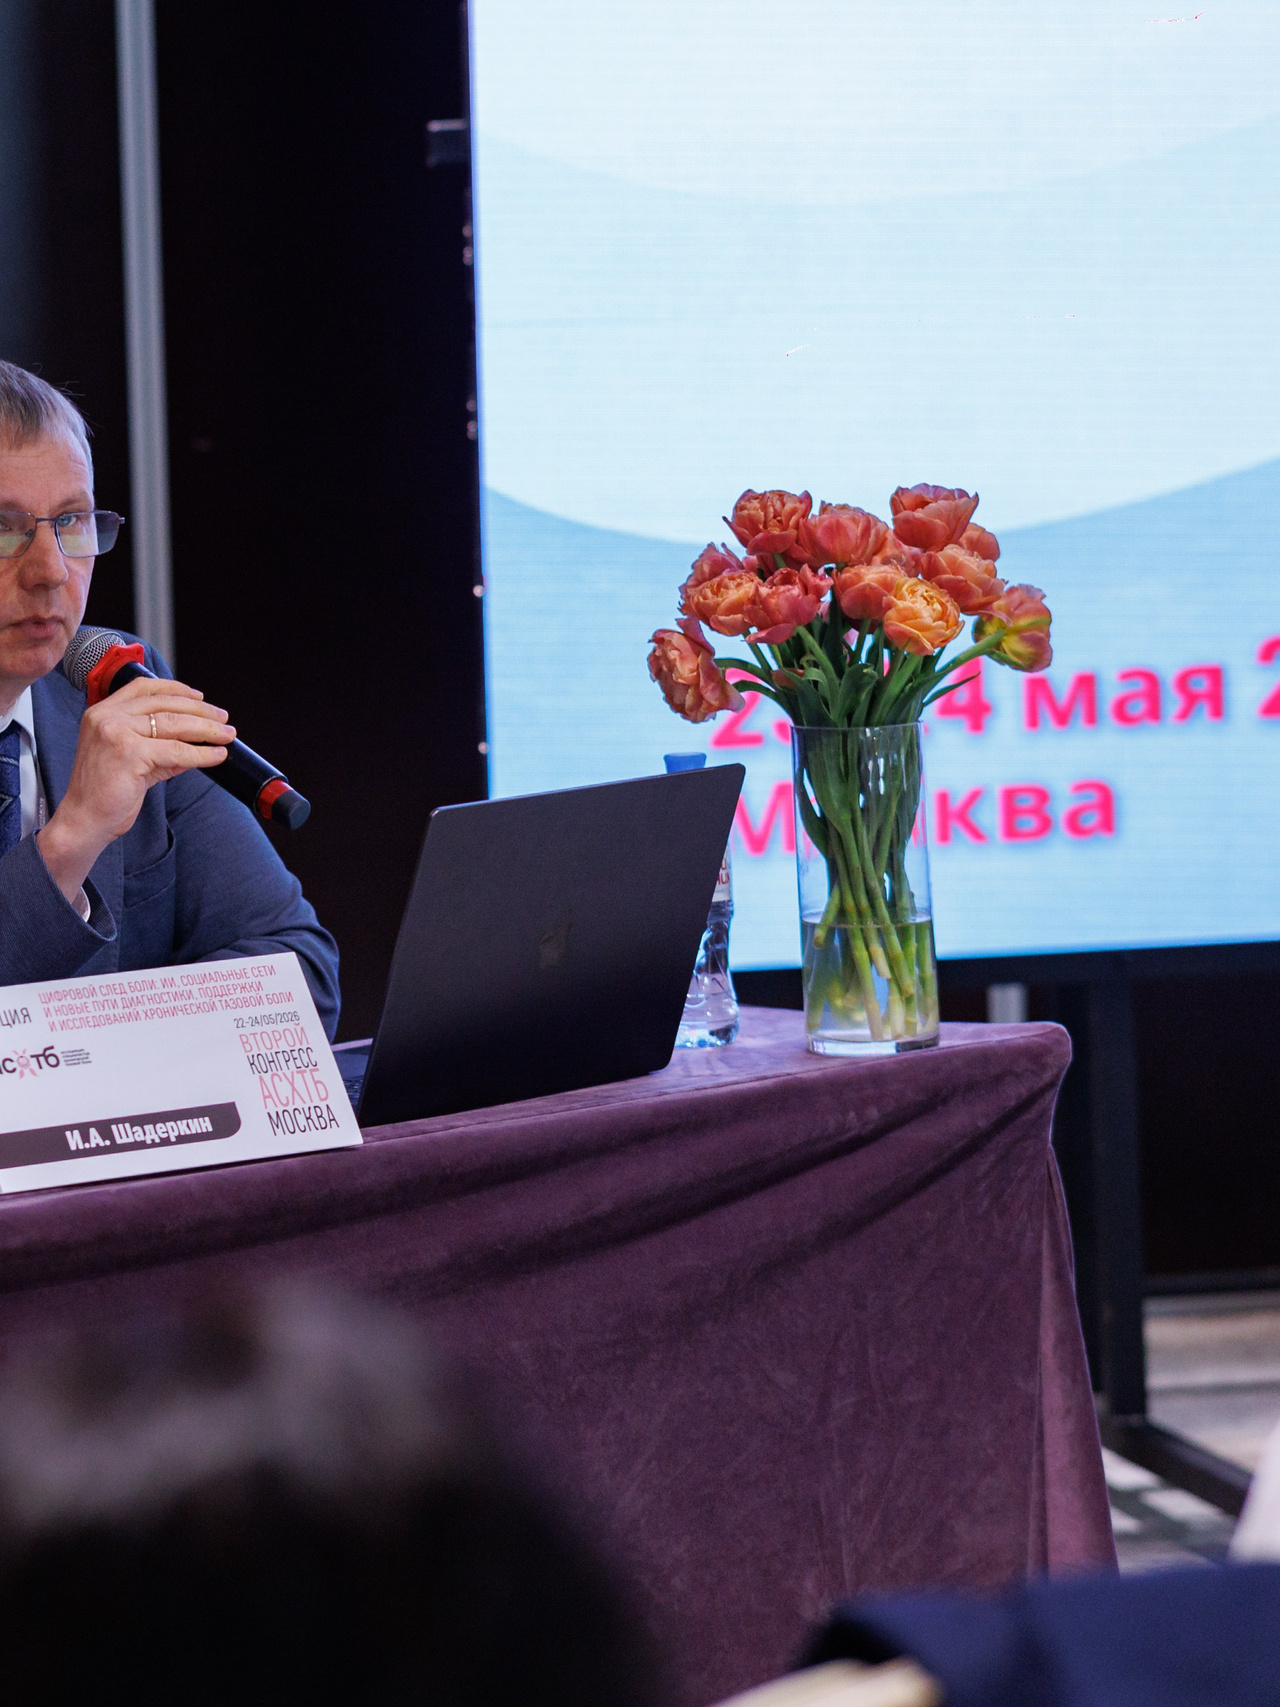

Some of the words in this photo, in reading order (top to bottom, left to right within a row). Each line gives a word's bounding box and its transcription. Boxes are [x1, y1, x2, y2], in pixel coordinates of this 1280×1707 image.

[1023, 664, 1224, 731] мая
[730, 777, 1116, 857] Мква
[38, 984, 98, 1005] ЦИФРОВОЙ
[99, 982, 127, 997] СЛЕД
[127, 979, 159, 994] БОЛИ:
[180, 968, 250, 988] СОЦИАЛЬНЫЕ
[251, 964, 277, 979] СЕТИ
[42, 1007, 53, 1019] И
[54, 1001, 90, 1018] НОВЫЕ
[92, 998, 119, 1013] ПУТИ
[198, 980, 264, 999] ПОДДЕРЖКИ
[48, 1021, 58, 1033] И
[59, 1008, 141, 1032] ИССЛЕДОВАНИЙ
[144, 998, 218, 1021] ХРОНИЧЕСКОЙ
[219, 992, 264, 1011] ТАЗОВОЙ
[265, 991, 294, 1005] БОЛИ
[234, 1011, 300, 1029] 22-24/05/2026
[238, 1022, 310, 1053] ВТОРОЙ
[247, 1047, 318, 1075] КОНГРЕСС
[258, 1067, 329, 1109] АСХТБ
[64, 1127, 111, 1151] И.А.
[111, 1116, 213, 1144] Шадеркин
[267, 1103, 340, 1137] МОСКВА
